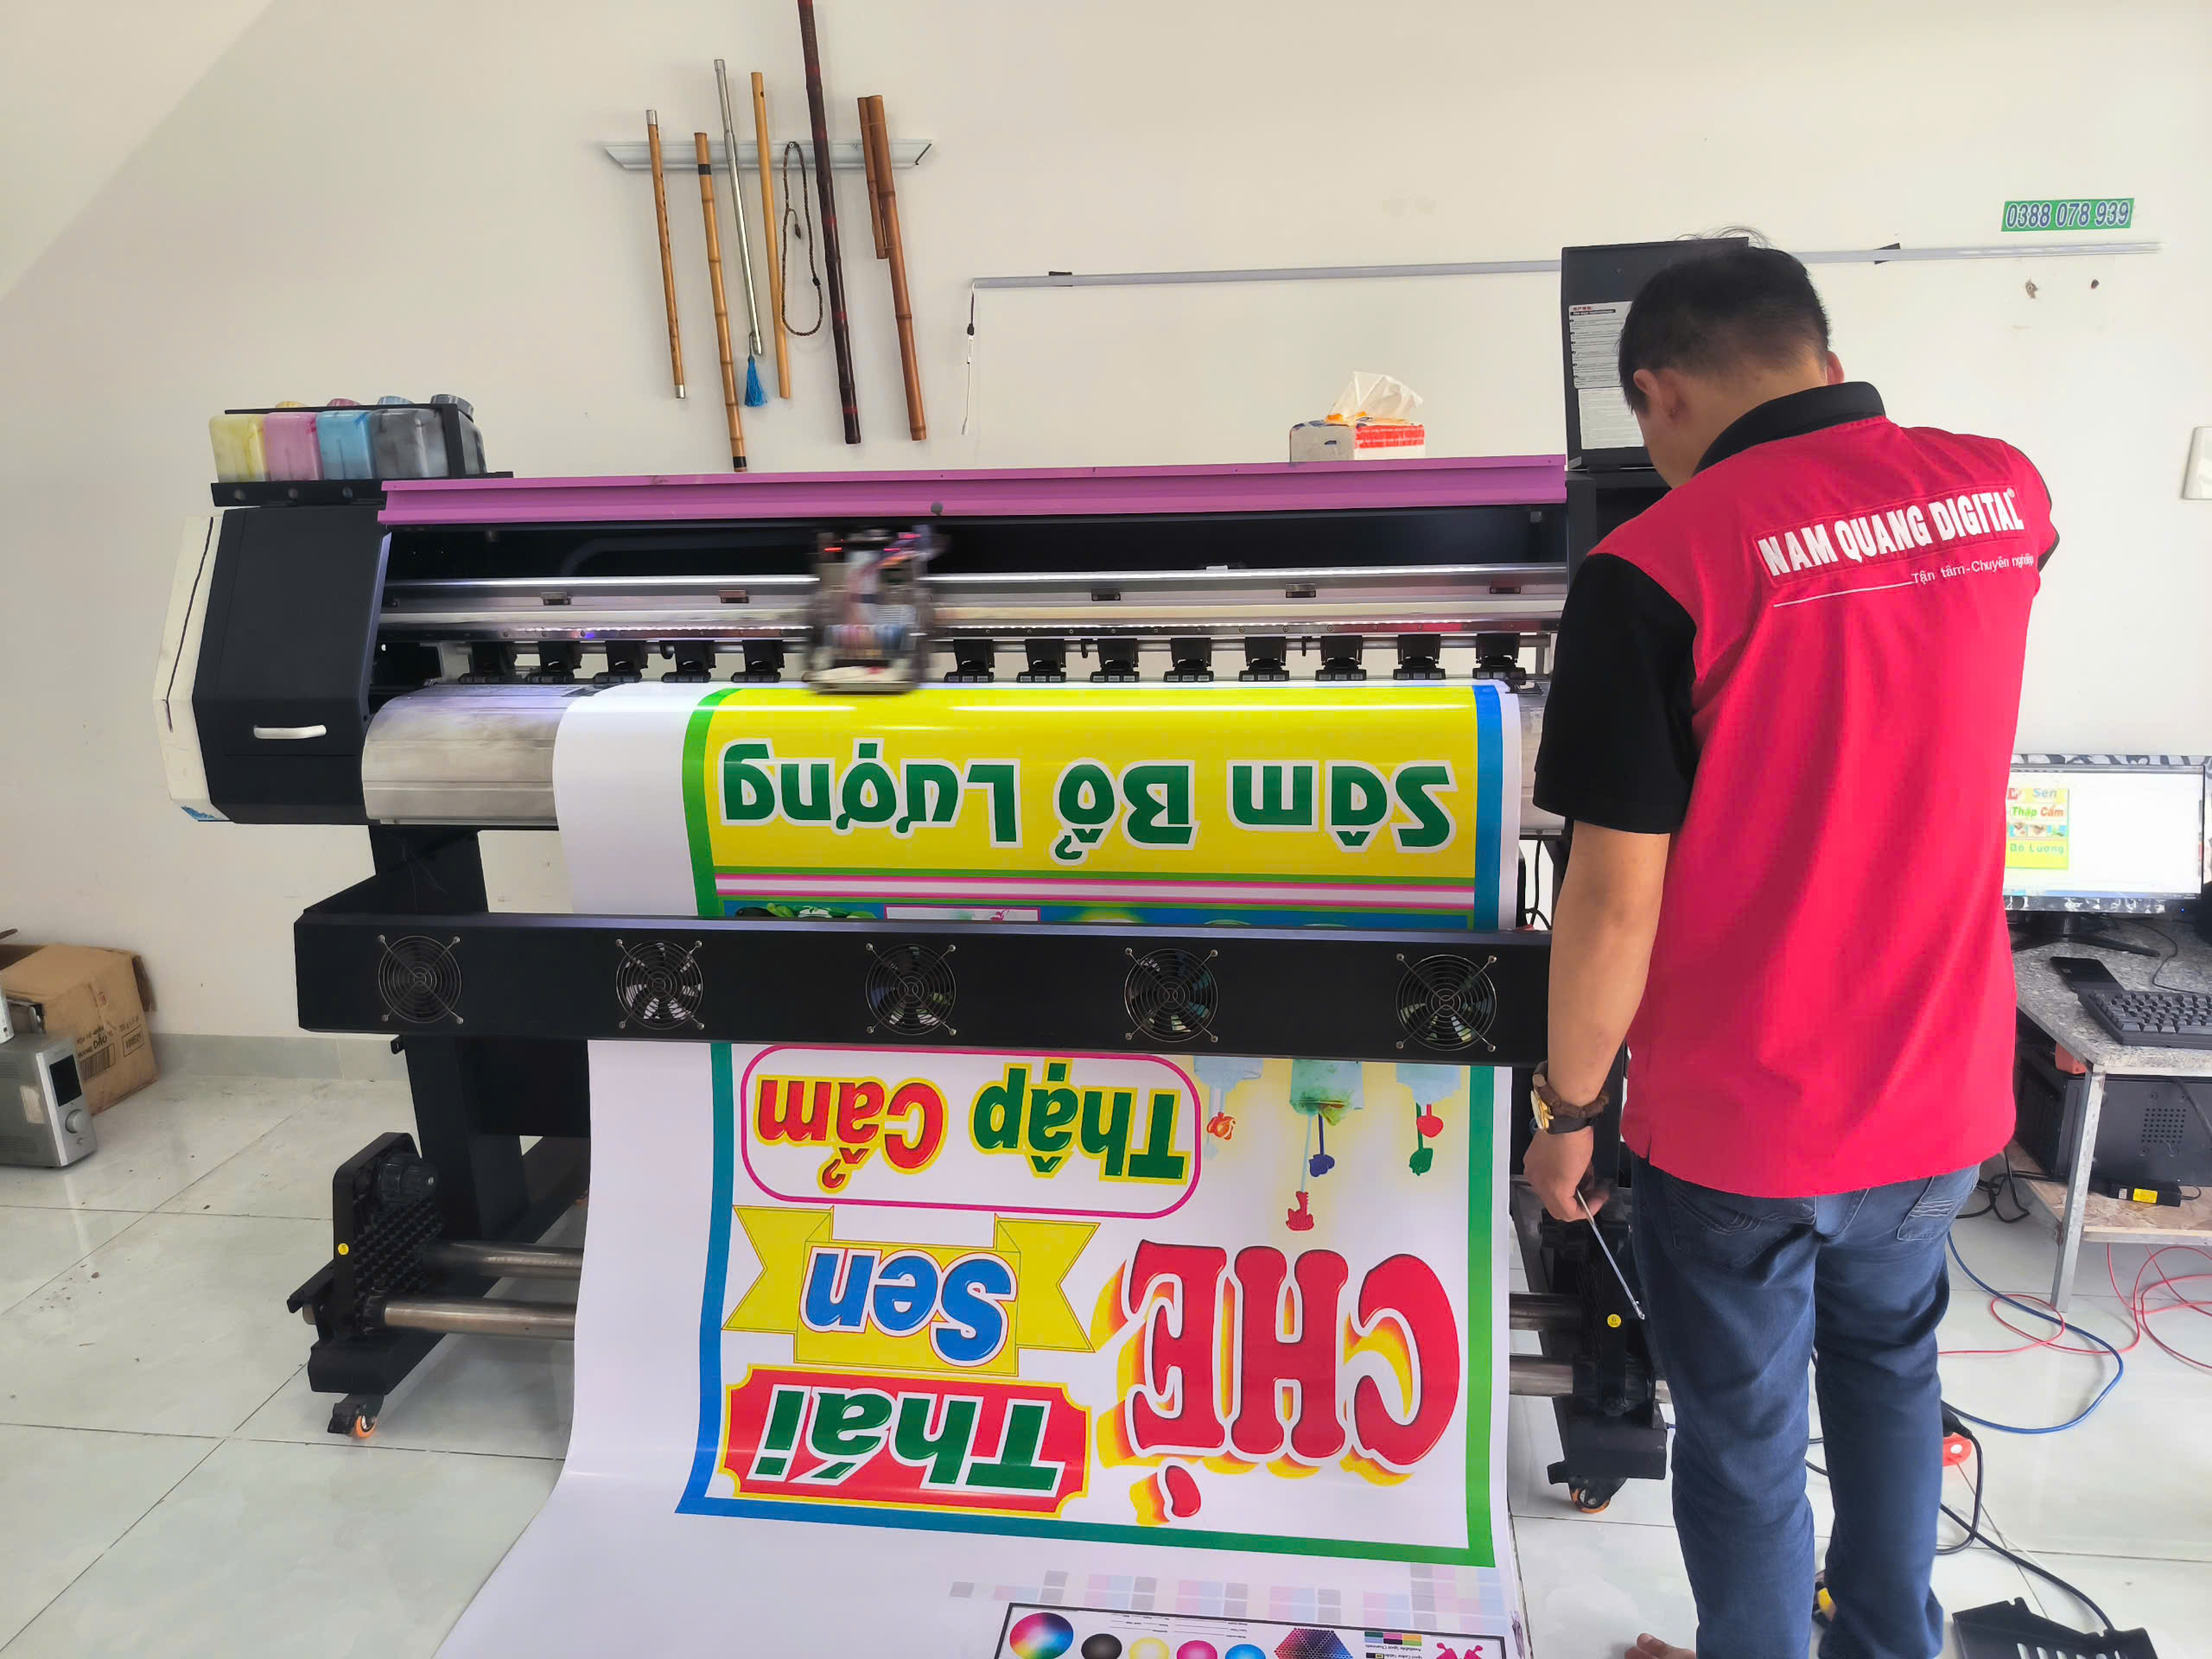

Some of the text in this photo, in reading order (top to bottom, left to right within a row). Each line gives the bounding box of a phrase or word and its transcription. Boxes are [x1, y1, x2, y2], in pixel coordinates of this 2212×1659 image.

[2005, 200, 2130, 229] 0388 078 939
[1758, 490, 2025, 577] NAM QUANG DIGITAL
[1910, 569, 1936, 586] Tận
[717, 736, 1458, 865] Sâm Bổ Lượng
[753, 1058, 1192, 1192] Thập Cẩm
[799, 1246, 1019, 1367] Sen
[1123, 1238, 1462, 1521] CHÈ
[748, 1383, 1067, 1499] Thái
